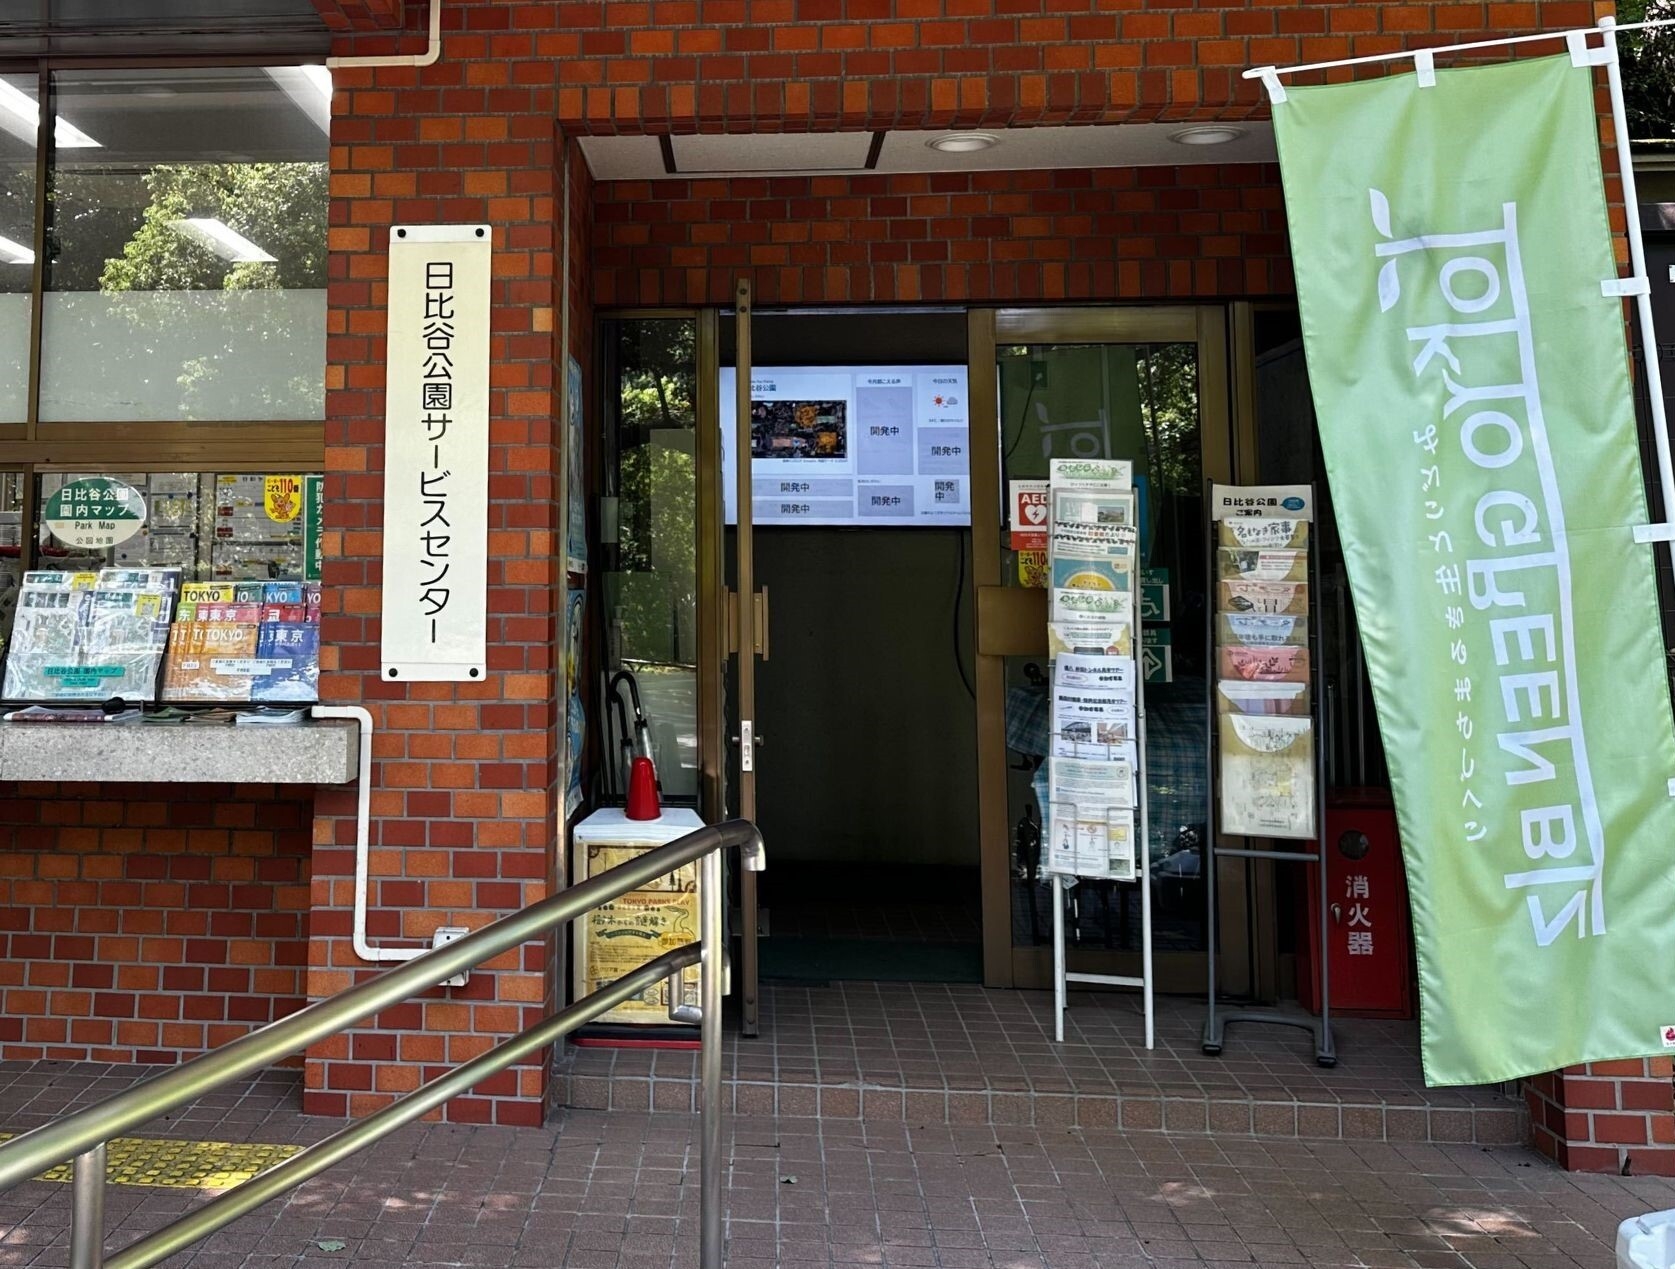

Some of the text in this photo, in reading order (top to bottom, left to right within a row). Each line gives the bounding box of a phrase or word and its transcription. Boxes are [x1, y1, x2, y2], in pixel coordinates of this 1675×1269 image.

[870, 426, 900, 436] 開発中
[418, 261, 455, 644] 日比谷公園サービスセンター
[931, 446, 961, 456] 開発中
[780, 483, 810, 492] 開発中
[935, 481, 955, 491] 開発
[61, 487, 129, 501] 日比谷公園
[935, 491, 945, 501] 中
[871, 496, 901, 506] 開発中
[1223, 497, 1278, 506] 日比谷公園
[60, 504, 129, 517] 園内マップ
[780, 504, 810, 514] 開発中
[1236, 509, 1263, 517] ご案内
[74, 521, 116, 531] Park Map
[1020, 552, 1048, 566] こども110
[184, 591, 221, 601] TOKYO
[210, 609, 238, 622] 東京
[206, 630, 243, 641] TOKYO
[275, 630, 305, 642] 東京
[1345, 875, 1375, 956] 消火器
